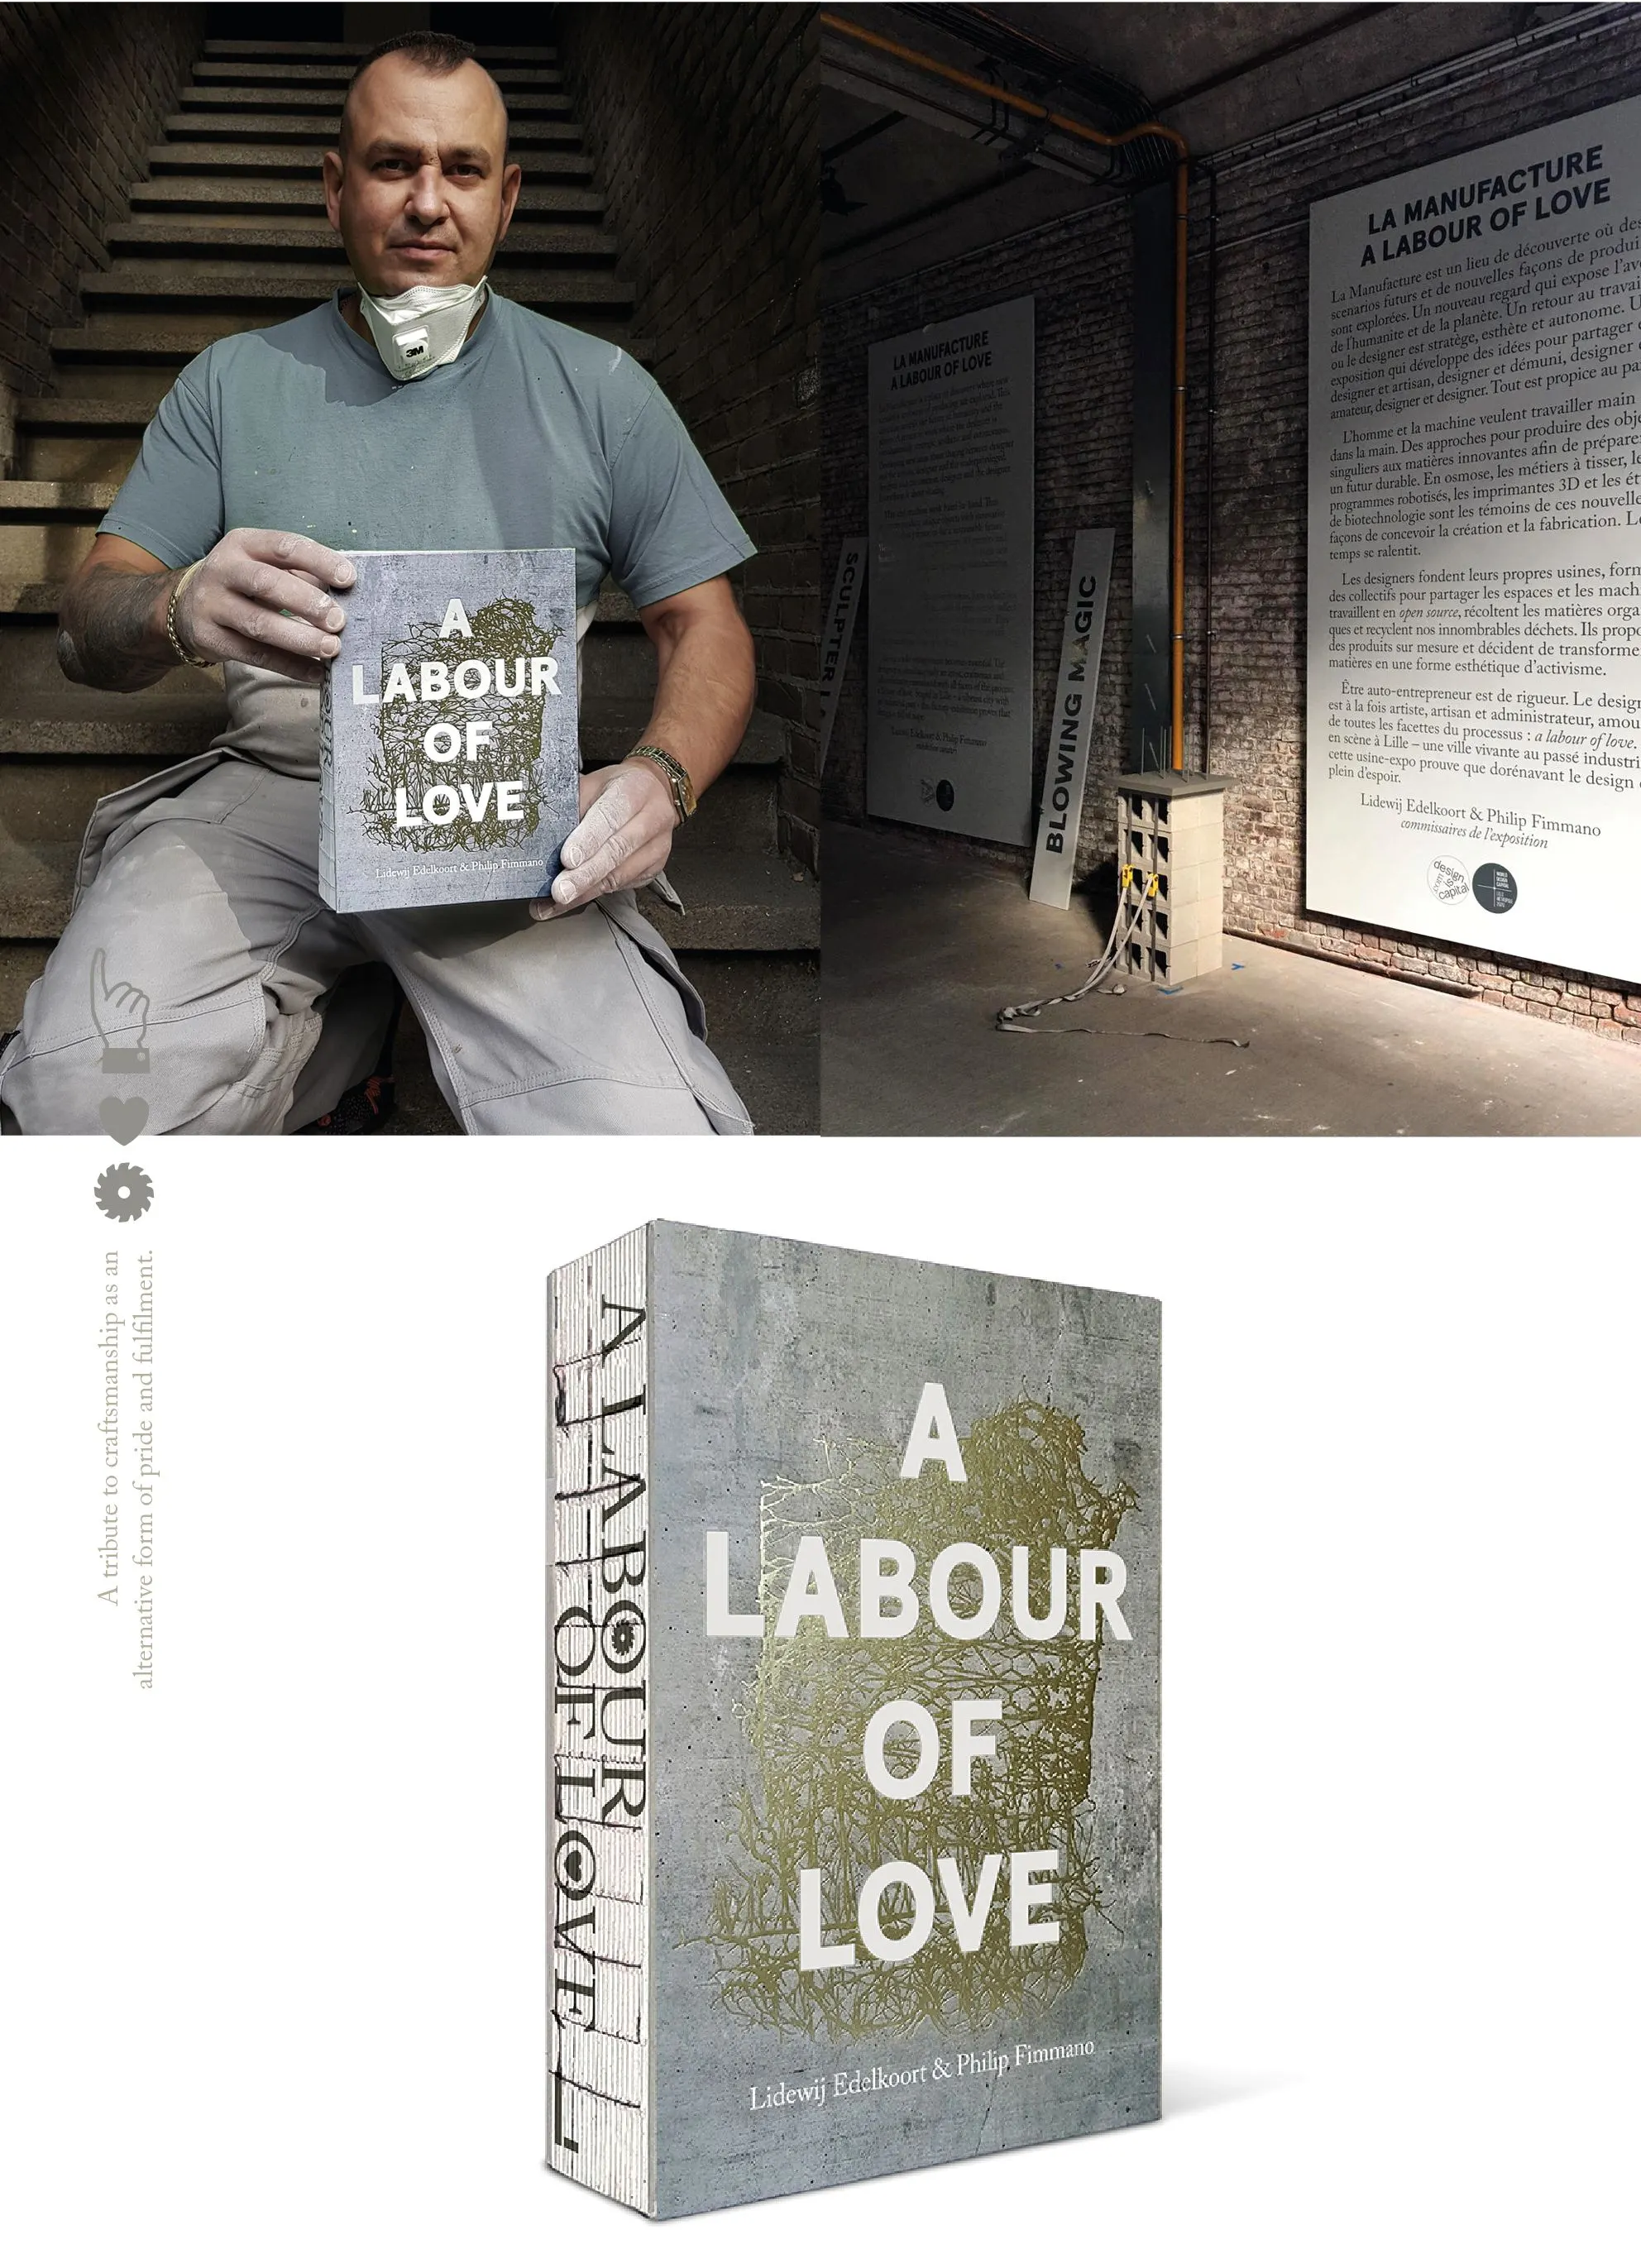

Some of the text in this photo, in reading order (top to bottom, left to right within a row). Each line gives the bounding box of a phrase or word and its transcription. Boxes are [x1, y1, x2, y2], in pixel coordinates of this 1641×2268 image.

[1368, 144, 1603, 235] LA MANUFACTURE
[1361, 177, 1610, 267] A LABOUR OF LOVE
[1331, 290, 1346, 304] La
[1349, 273, 1422, 299] Manufacture
[1425, 268, 1442, 280] est
[1446, 264, 1462, 275] un
[1466, 256, 1490, 271] lieu
[1494, 248, 1509, 264] de
[1514, 232, 1590, 259] découverte
[1595, 222, 1614, 239] où
[406, 346, 423, 358] 3M
[891, 351, 993, 390] A LABOUR OF LOVE
[893, 331, 989, 371] LA MANUFACTURE
[1330, 342, 1634, 404] designer et artisan, designer et démuni, designer
[1396, 426, 1408, 437] et
[1411, 421, 1421, 434] la
[1424, 416, 1476, 433] machine
[1479, 408, 1527, 425] veulent
[1531, 397, 1593, 418] travailler
[1598, 392, 1635, 409] main
[1329, 472, 1621, 515] programmes robotisés, les imprimantes 3D et les
[438, 598, 474, 639] A
[1329, 603, 1603, 623] travaillent en open source, récoltent les matières
[1328, 639, 1554, 656] des produits sur mesure et décident de
[1328, 656, 1372, 669] matières
[1375, 660, 1389, 669] en
[1392, 661, 1413, 670] une
[1416, 657, 1452, 672] forme
[1455, 658, 1520, 677] esthétique
[351, 656, 562, 705] LABOUR
[1045, 574, 1097, 854] BLOWING MAGIC
[1328, 701, 1343, 711] est
[1346, 699, 1352, 711] à
[1354, 699, 1364, 712] la
[1366, 699, 1386, 714] fois
[1390, 702, 1428, 719] artiste,
[1430, 705, 1471, 719] artisan
[1475, 710, 1487, 720] et
[1490, 706, 1594, 729] administrateur,
[1328, 714, 1637, 752] de toutes les facettes du processus a labour of love.
[423, 720, 494, 763] OF
[1328, 734, 1341, 744] en
[1343, 733, 1371, 746] scène
[1374, 734, 1380, 747] à
[1383, 734, 1409, 749] Lille
[1423, 742, 1444, 752] une
[1447, 740, 1471, 754] ville
[1475, 743, 1519, 758] vivante
[1524, 749, 1539, 760] au
[1543, 751, 1579, 766] passé
[1328, 750, 1634, 792] cette usine-expo prouve que dorénavant le design
[1328, 763, 1354, 780] plein
[395, 780, 524, 829] LOVE
[1361, 792, 1601, 836] Lidewij Edelkoort & Philip Fimmano
[1400, 820, 1467, 837] commissaires
[1468, 825, 1482, 840] de
[376, 859, 543, 879] Lidewij Edelkoort & Philip Fimmano
[1433, 860, 1465, 883] design
[1443, 878, 1454, 888] is
[1438, 883, 1470, 900] capital
[601, 1293, 647, 1368] A
[901, 1382, 966, 1482] A
[706, 1531, 1132, 1641] LABOUR
[863, 1700, 1002, 1800] OF
[800, 1849, 1060, 1970] LOVE
[750, 2041, 1094, 2111] Lidewij Edelkoort & Philip Fimmano
